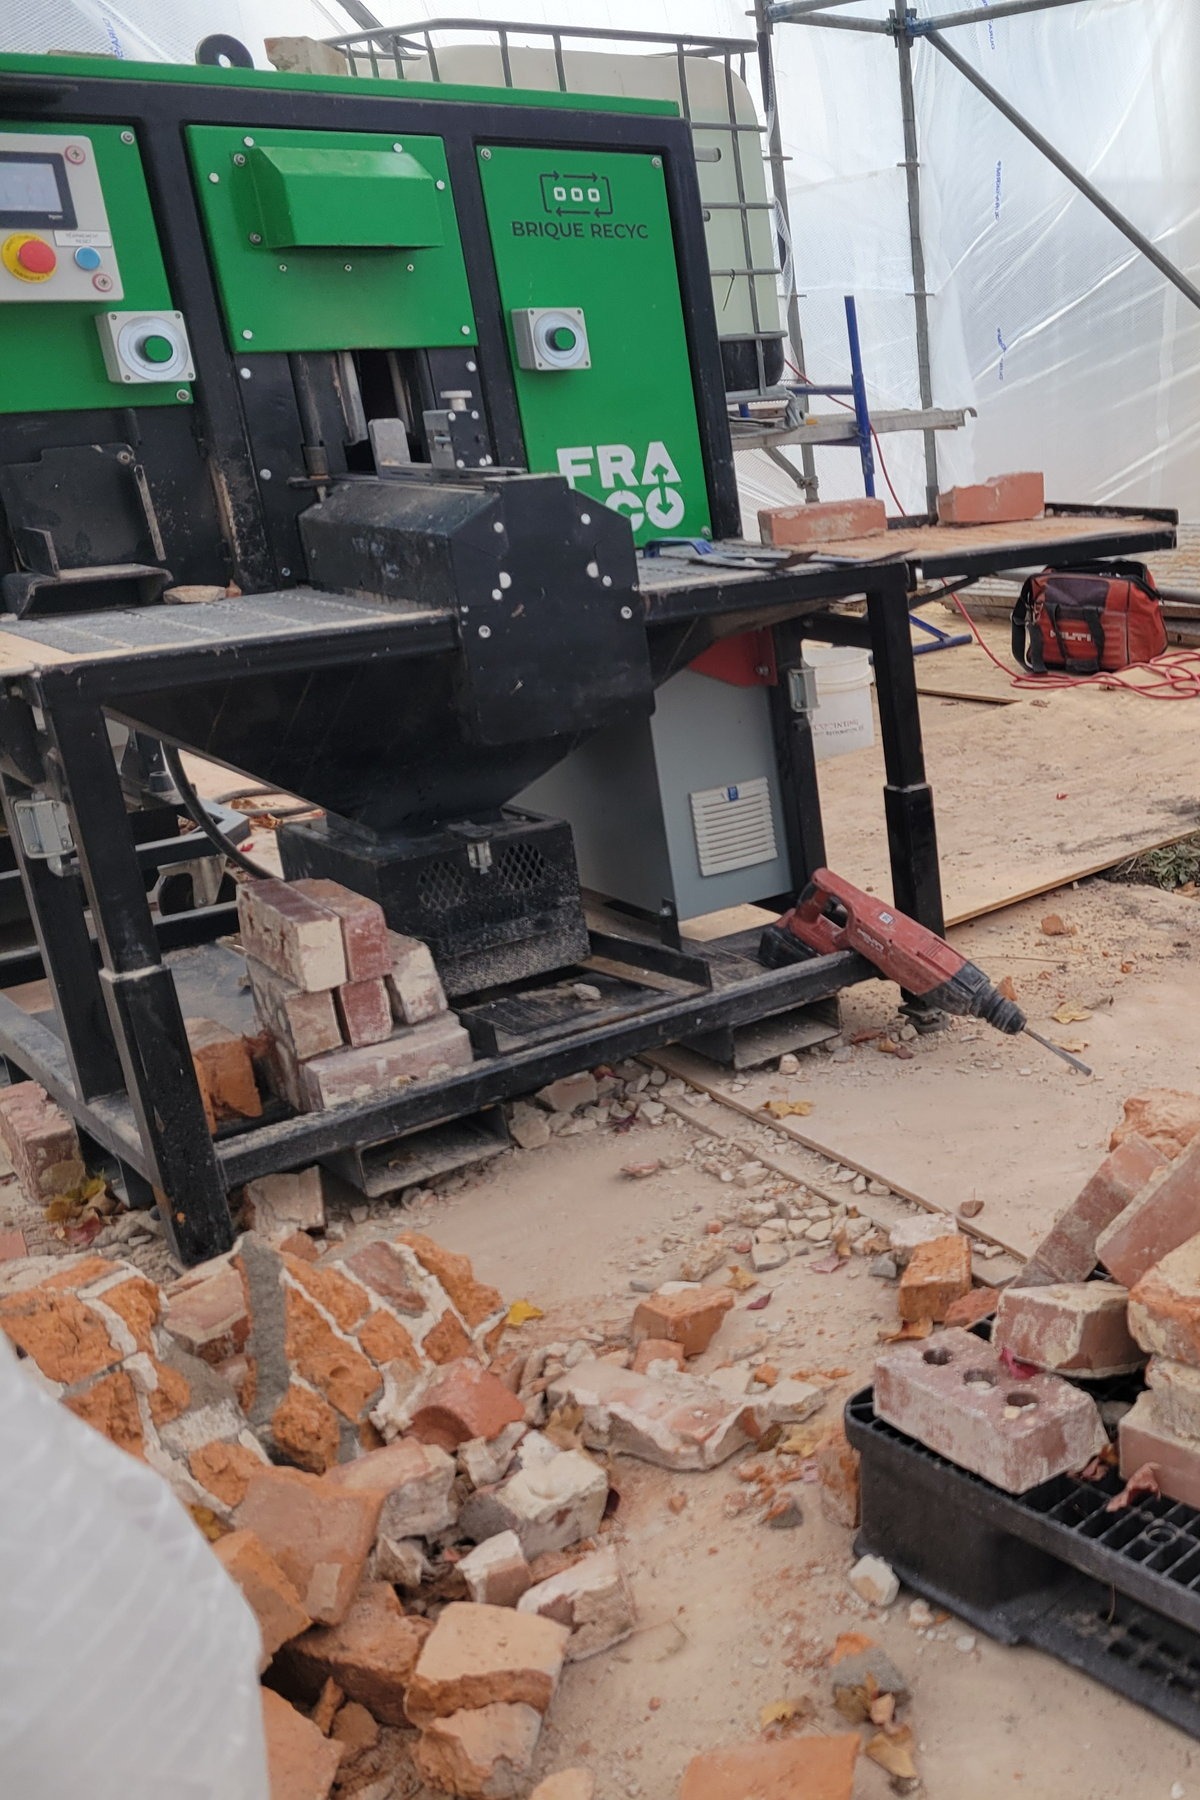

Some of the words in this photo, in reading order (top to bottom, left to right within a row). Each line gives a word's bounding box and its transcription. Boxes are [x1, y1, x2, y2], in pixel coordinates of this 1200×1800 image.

[511, 221, 585, 240] BRIQUE
[590, 223, 649, 239] RECYC
[556, 441, 682, 489] FRA
[605, 486, 685, 532] CO
